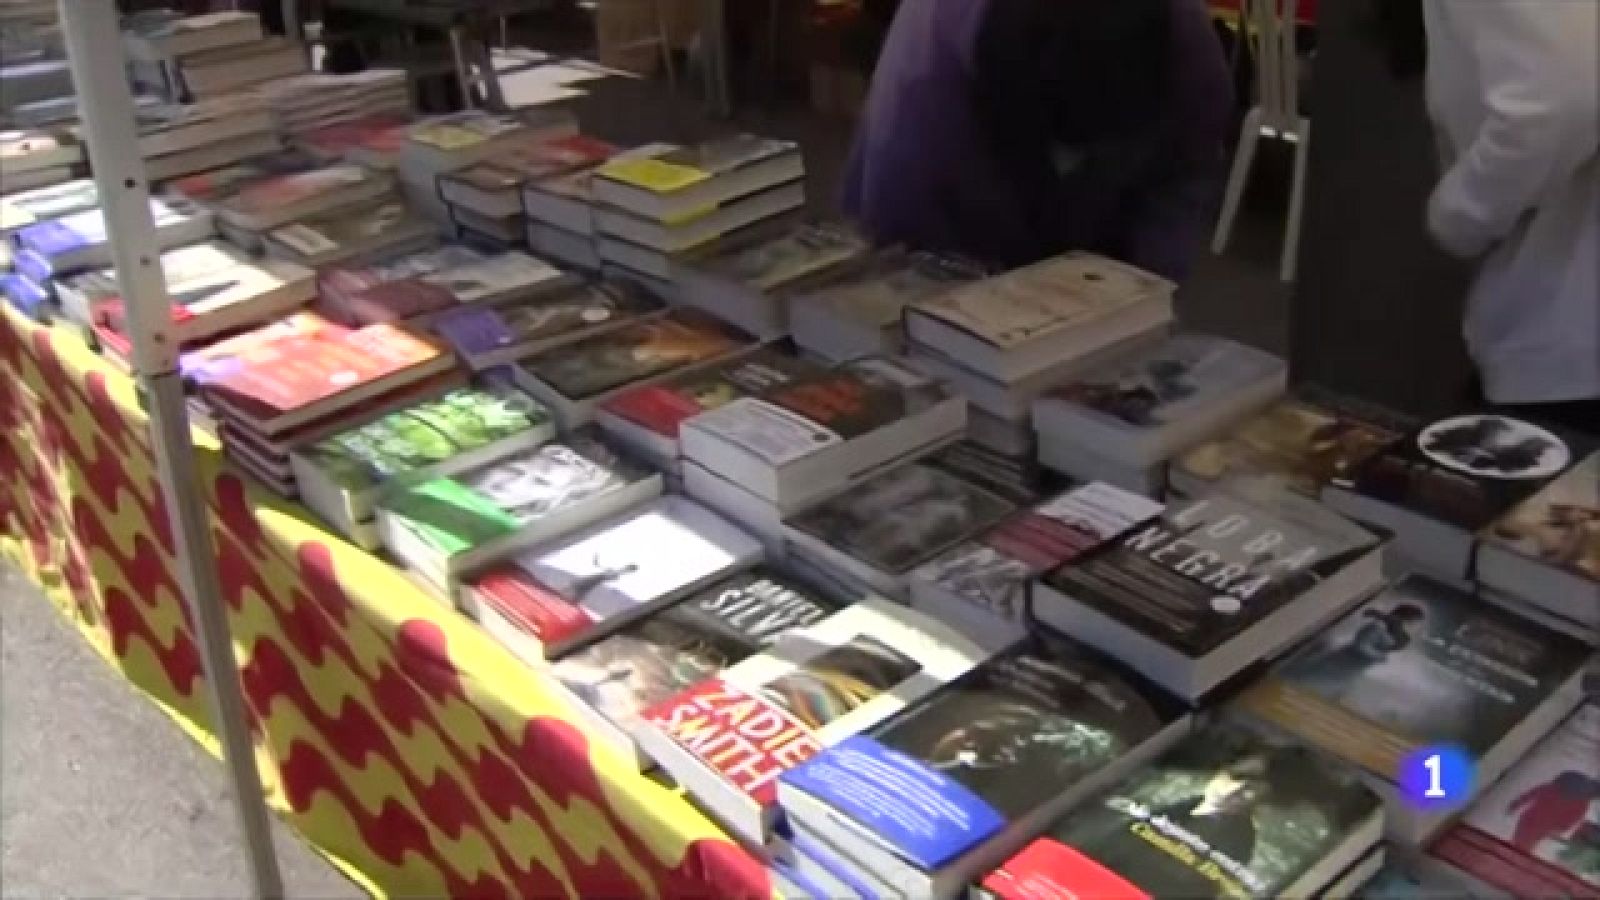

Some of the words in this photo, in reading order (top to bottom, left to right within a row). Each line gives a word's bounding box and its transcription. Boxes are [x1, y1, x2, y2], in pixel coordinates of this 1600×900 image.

[1124, 526, 1272, 598] NEGRA
[1174, 501, 1318, 571] LOBA
[655, 703, 784, 791] SMITH
[692, 685, 824, 769] ZADIE
